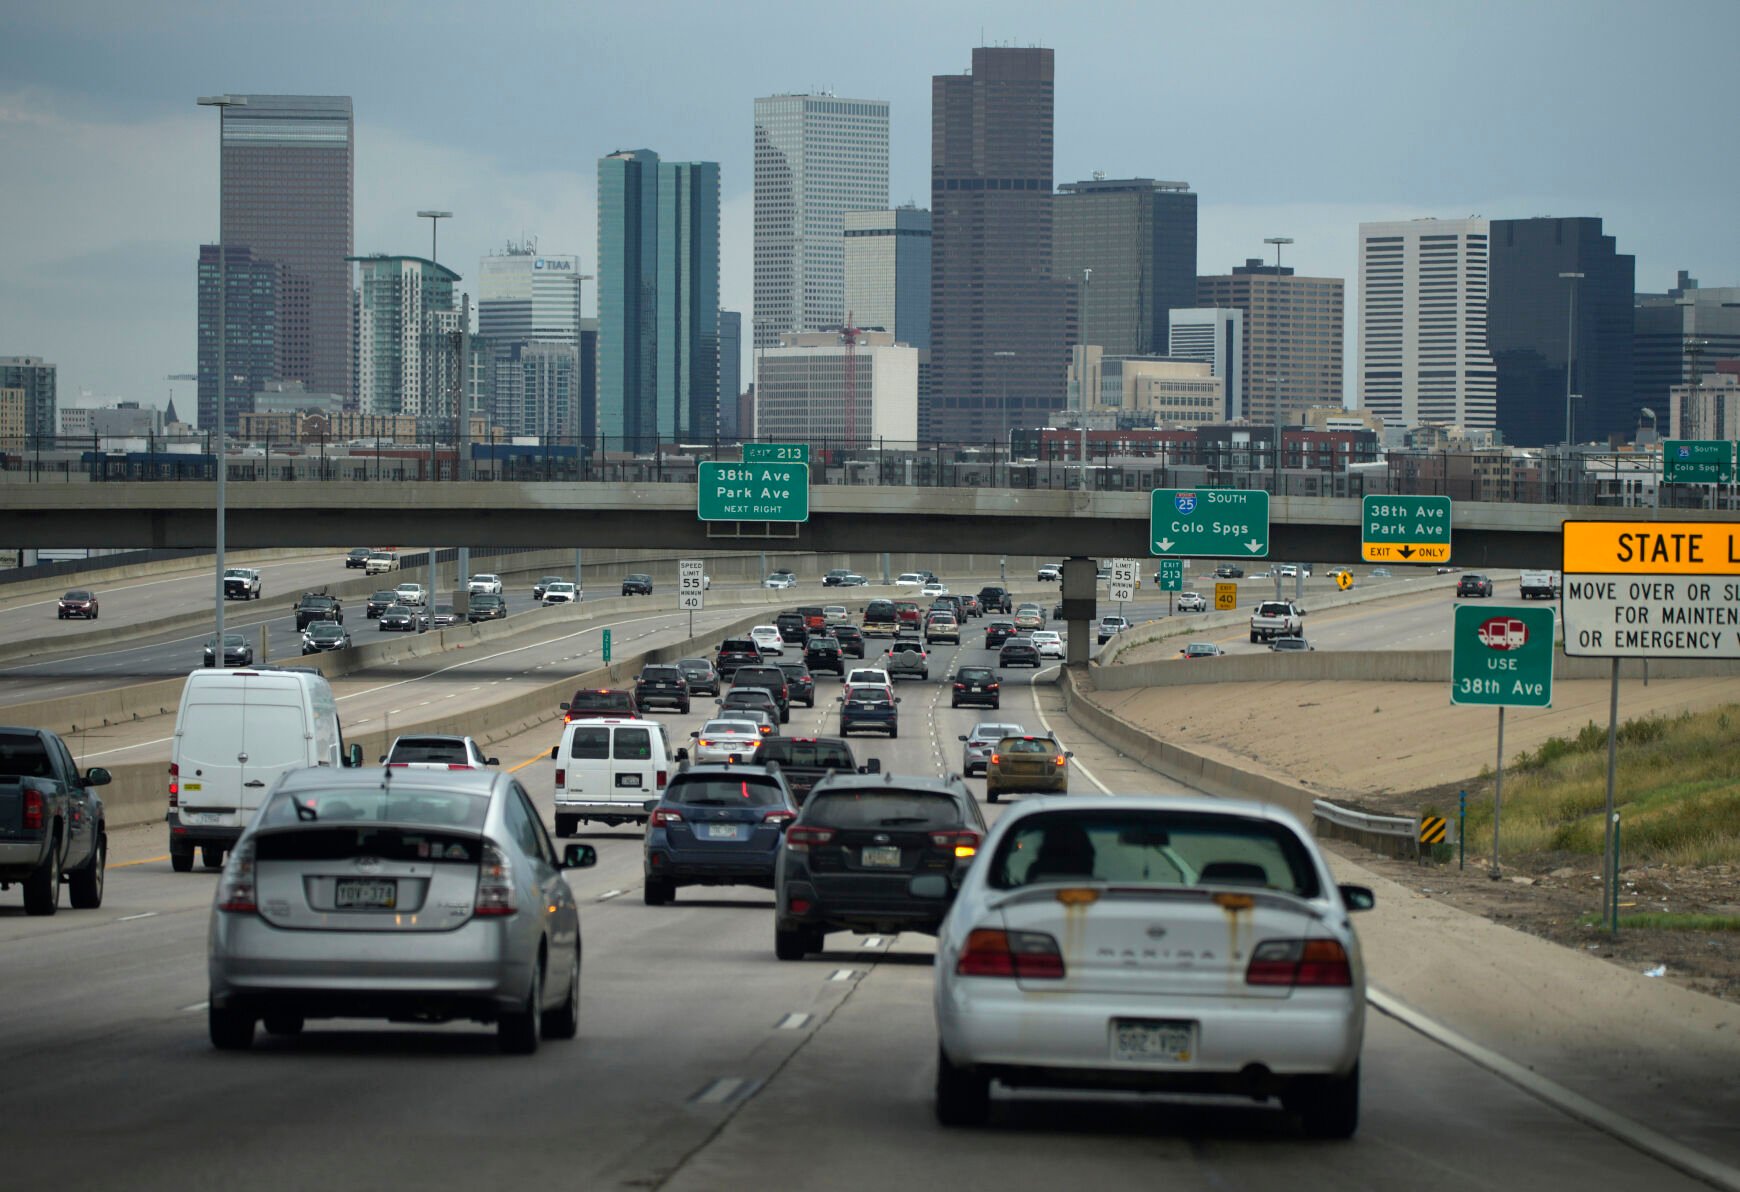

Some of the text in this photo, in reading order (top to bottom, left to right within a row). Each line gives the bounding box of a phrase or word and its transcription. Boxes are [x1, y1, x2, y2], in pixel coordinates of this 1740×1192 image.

[545, 260, 571, 270] TIAA
[749, 448, 801, 459] EXIT 213
[1679, 445, 1719, 457] 25 SOUTH
[717, 469, 791, 481] 38th Ave
[717, 486, 790, 499] Park Ave
[1207, 491, 1247, 504] SOUTH
[724, 505, 783, 513] NEXT RIGHT
[1178, 499, 1194, 510] 25
[1371, 505, 1444, 518] 38th Ave
[1171, 521, 1249, 537] Colo Spgs
[1370, 522, 1443, 535] Park Ave
[1370, 547, 1445, 557] EXIT ONLY
[1617, 533, 1740, 563] STATE L
[1115, 570, 1131, 581] 55
[1162, 570, 1180, 579] 213
[683, 578, 700, 588] 55
[1115, 590, 1128, 599] 40
[1569, 582, 1740, 601] MOVE OVER OR SL
[684, 598, 698, 607] 40
[1219, 594, 1233, 603] 40
[1615, 606, 1738, 625] FOR MAINTEN
[1579, 630, 1603, 648] OR
[1615, 631, 1721, 649] EMERGENCY
[1487, 657, 1518, 671] USE
[1460, 677, 1544, 696] 38th Ave
